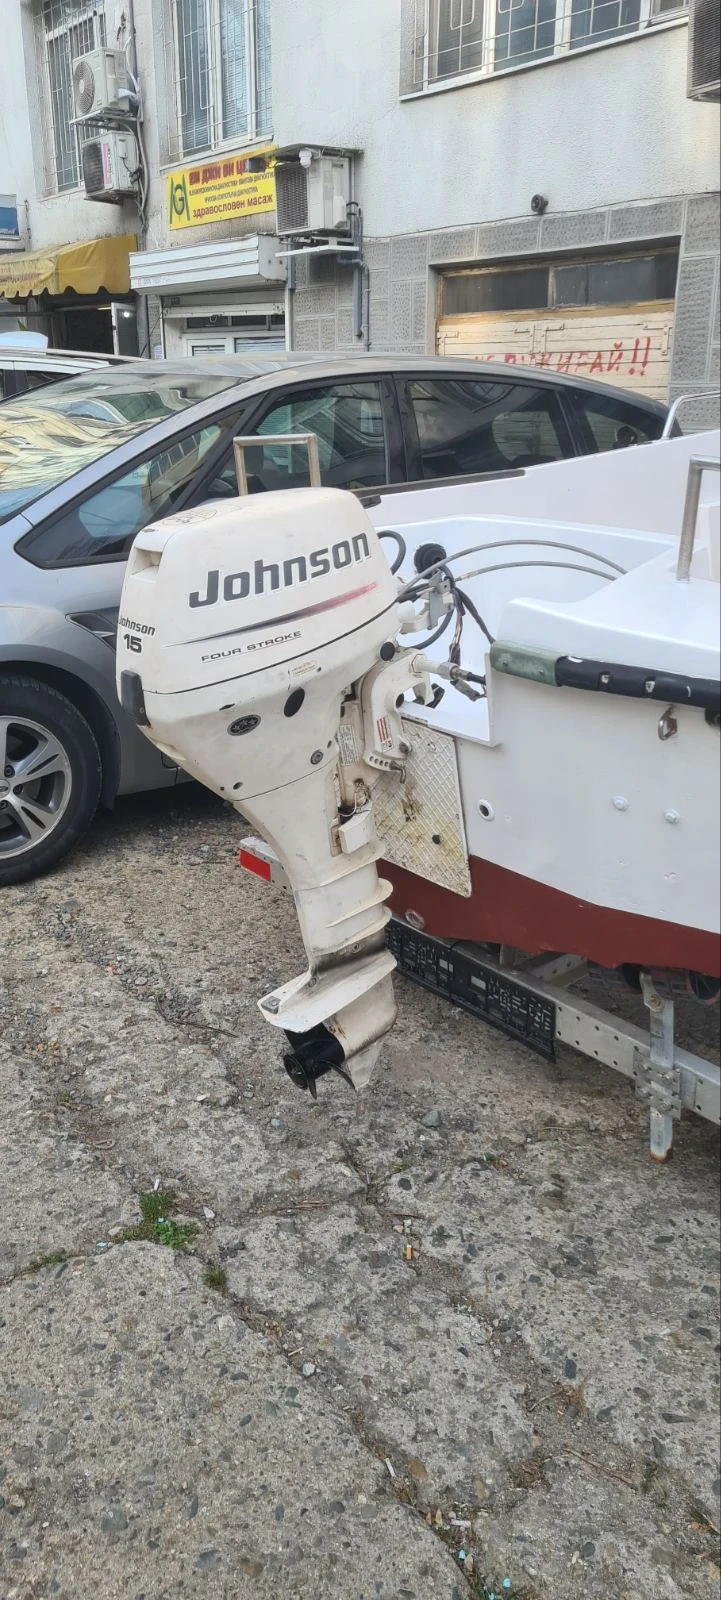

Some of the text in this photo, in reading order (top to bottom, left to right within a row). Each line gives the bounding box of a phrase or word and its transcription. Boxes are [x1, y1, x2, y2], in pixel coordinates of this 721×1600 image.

[193, 200, 246, 220] здравословен
[247, 194, 273, 207] масаж
[189, 532, 370, 609] Johnson
[118, 616, 156, 636] Johnson
[123, 633, 142, 654] 15
[201, 630, 302, 662] FOUR STROKE
